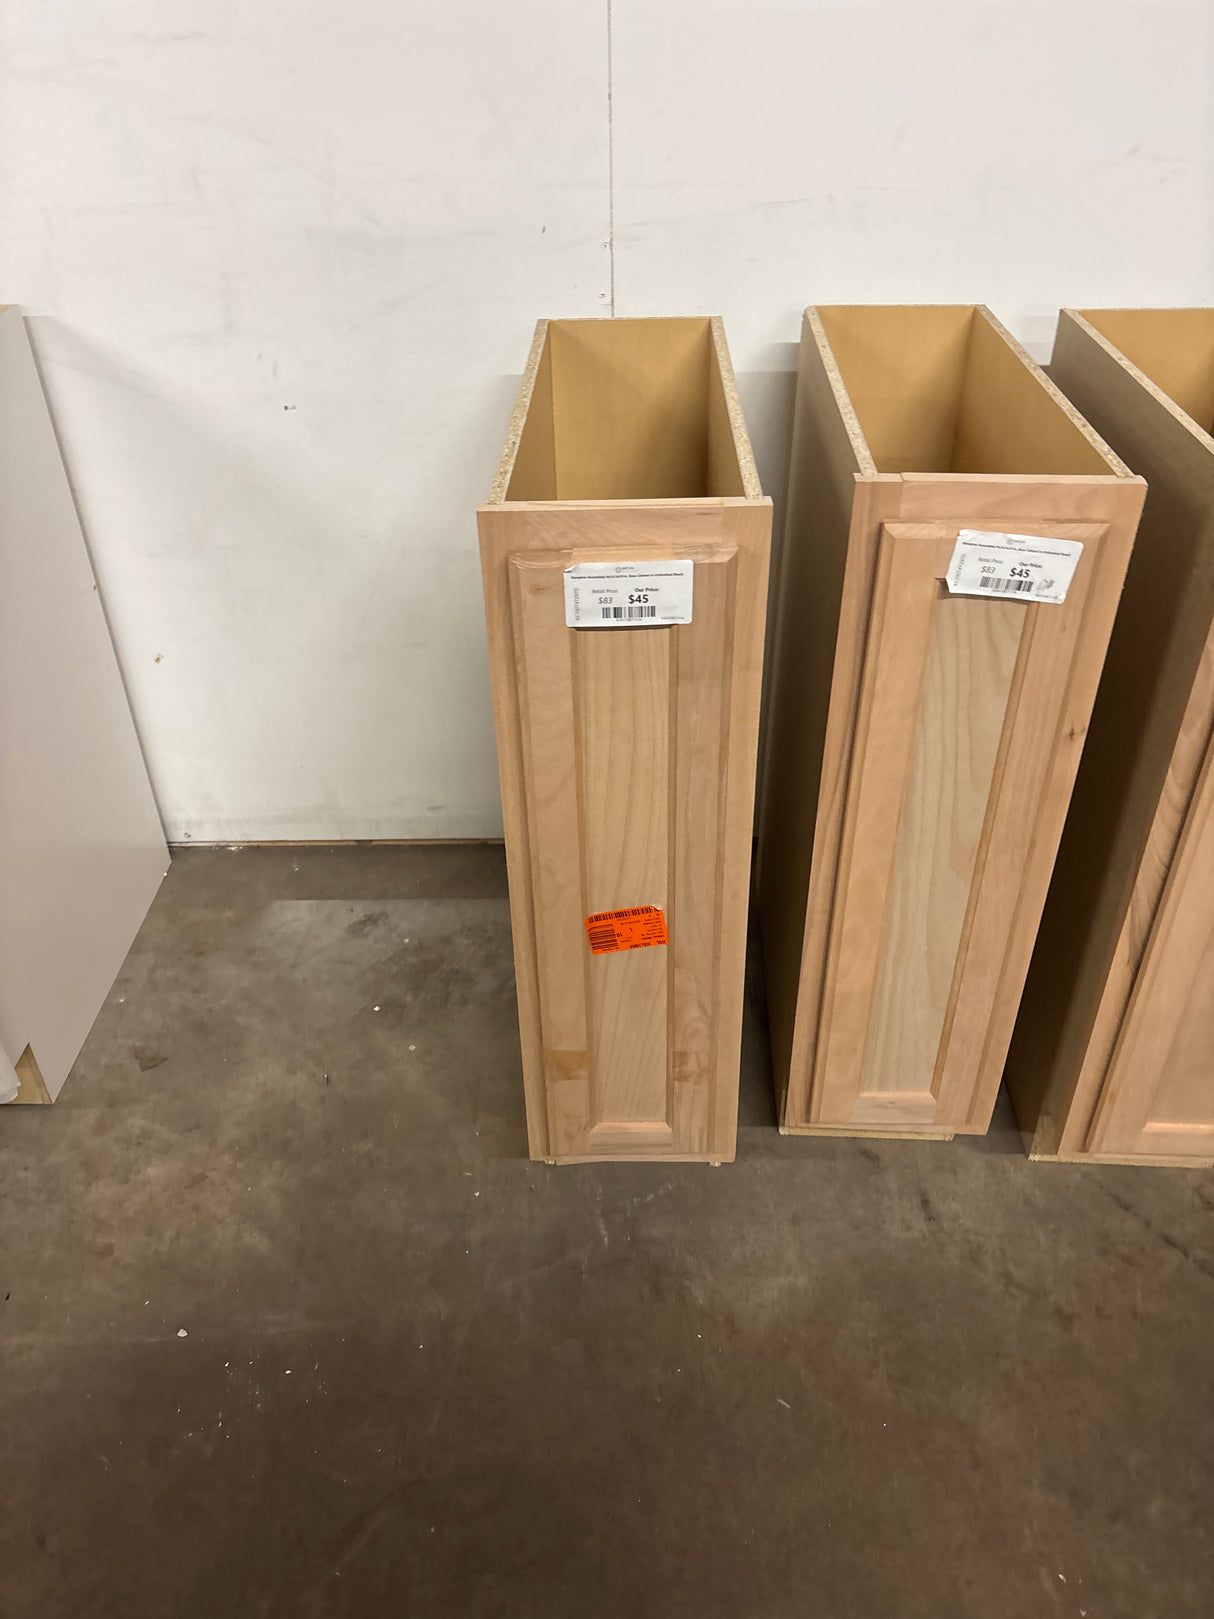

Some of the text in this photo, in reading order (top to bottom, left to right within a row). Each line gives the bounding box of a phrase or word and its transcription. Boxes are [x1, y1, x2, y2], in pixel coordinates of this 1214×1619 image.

[1009, 567, 1031, 579] $45
[598, 596, 614, 605] $83
[628, 593, 650, 605] $45
